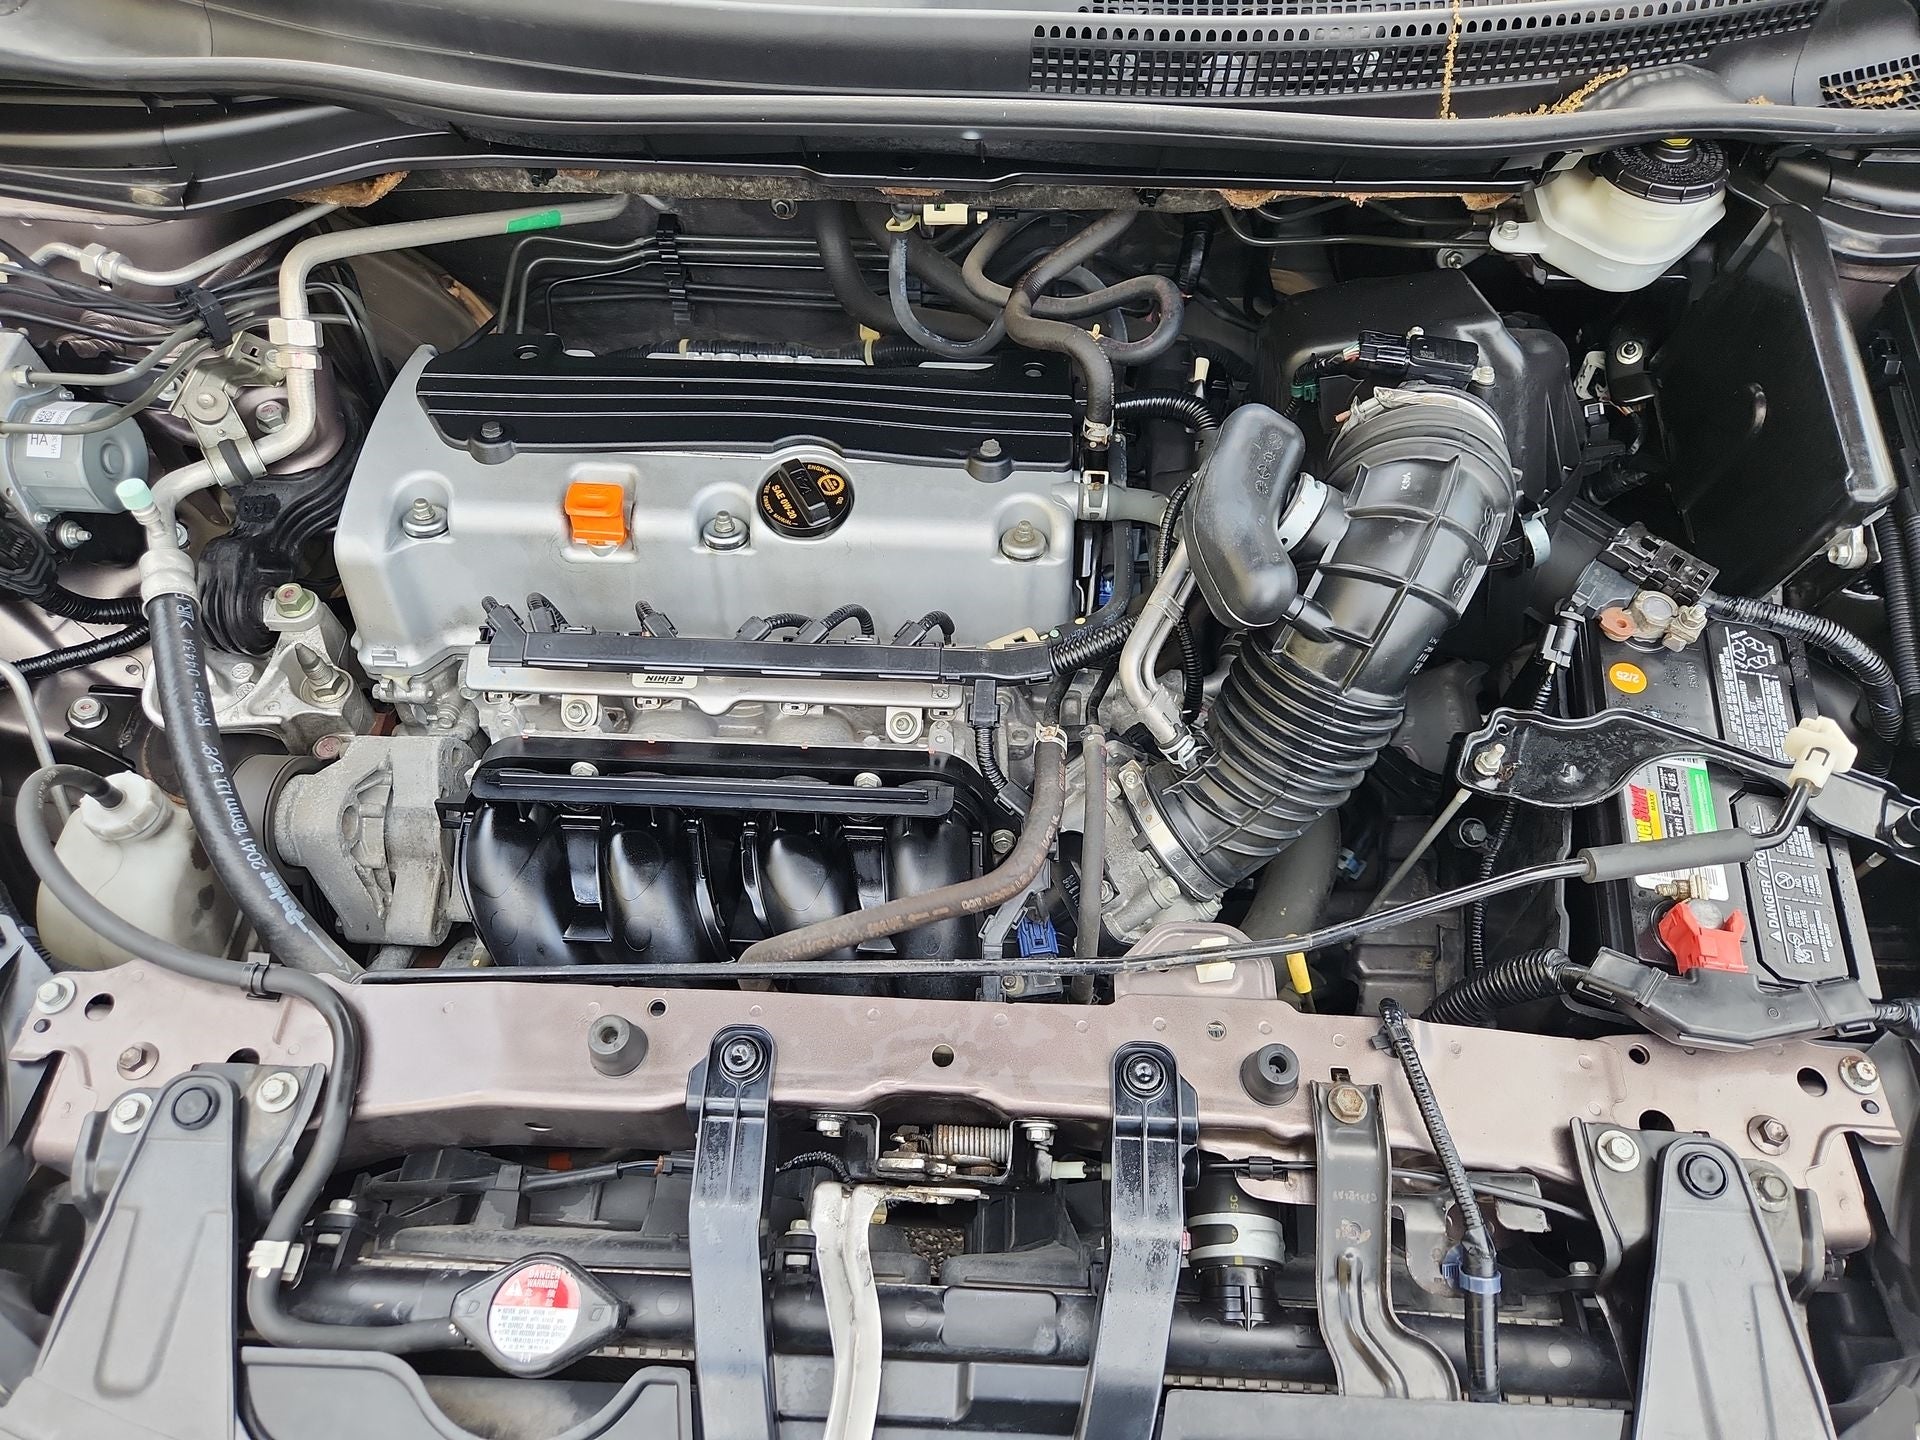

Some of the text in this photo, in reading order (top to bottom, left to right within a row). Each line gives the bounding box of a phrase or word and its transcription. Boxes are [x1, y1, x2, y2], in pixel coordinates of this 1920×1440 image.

[807, 464, 831, 475] ENGINE
[771, 484, 798, 520] SAE 0W-20
[773, 513, 792, 525] MANUAL
[181, 638, 201, 677] 0443A
[1615, 669, 1639, 683] 2/25
[1738, 680, 1757, 745] FLUSH EYES IMMEDIATELY
[1749, 700, 1758, 711] GET
[1755, 696, 1771, 747] MEDICAL HELP FAST
[1755, 733, 1764, 746] WITH
[1668, 773, 1677, 787] 625
[1672, 797, 1681, 811] 500
[225, 797, 249, 836] 16mm
[238, 837, 267, 870] 2041
[1795, 879, 1802, 887] NO
[259, 871, 305, 926] Parker
[1785, 905, 1795, 927] SHIELD
[1793, 912, 1802, 928] EYES
[1800, 910, 1812, 944] EXPLOSIVE
[1810, 924, 1819, 944] GASES
[528, 1269, 561, 1279] DANGER
